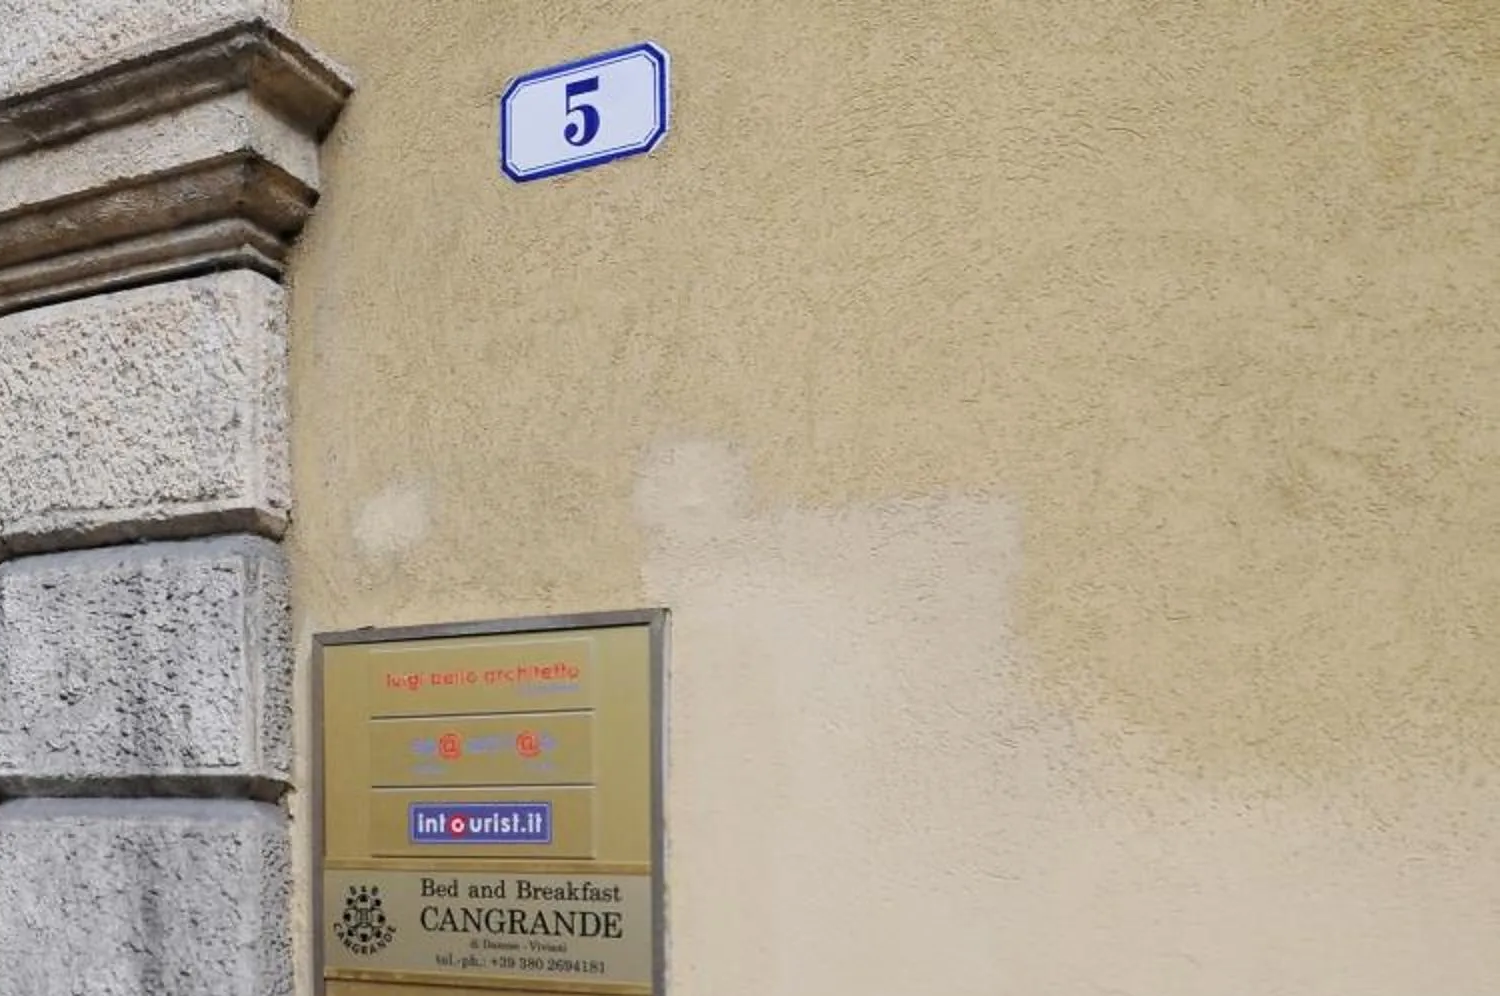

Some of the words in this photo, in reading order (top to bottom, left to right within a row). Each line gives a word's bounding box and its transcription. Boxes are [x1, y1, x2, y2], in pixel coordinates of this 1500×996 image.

[564, 76, 600, 146] 5
[420, 878, 458, 898] Bed
[468, 880, 506, 899] and
[516, 880, 622, 903] Breakfast
[419, 905, 623, 939] CANGRANDE
